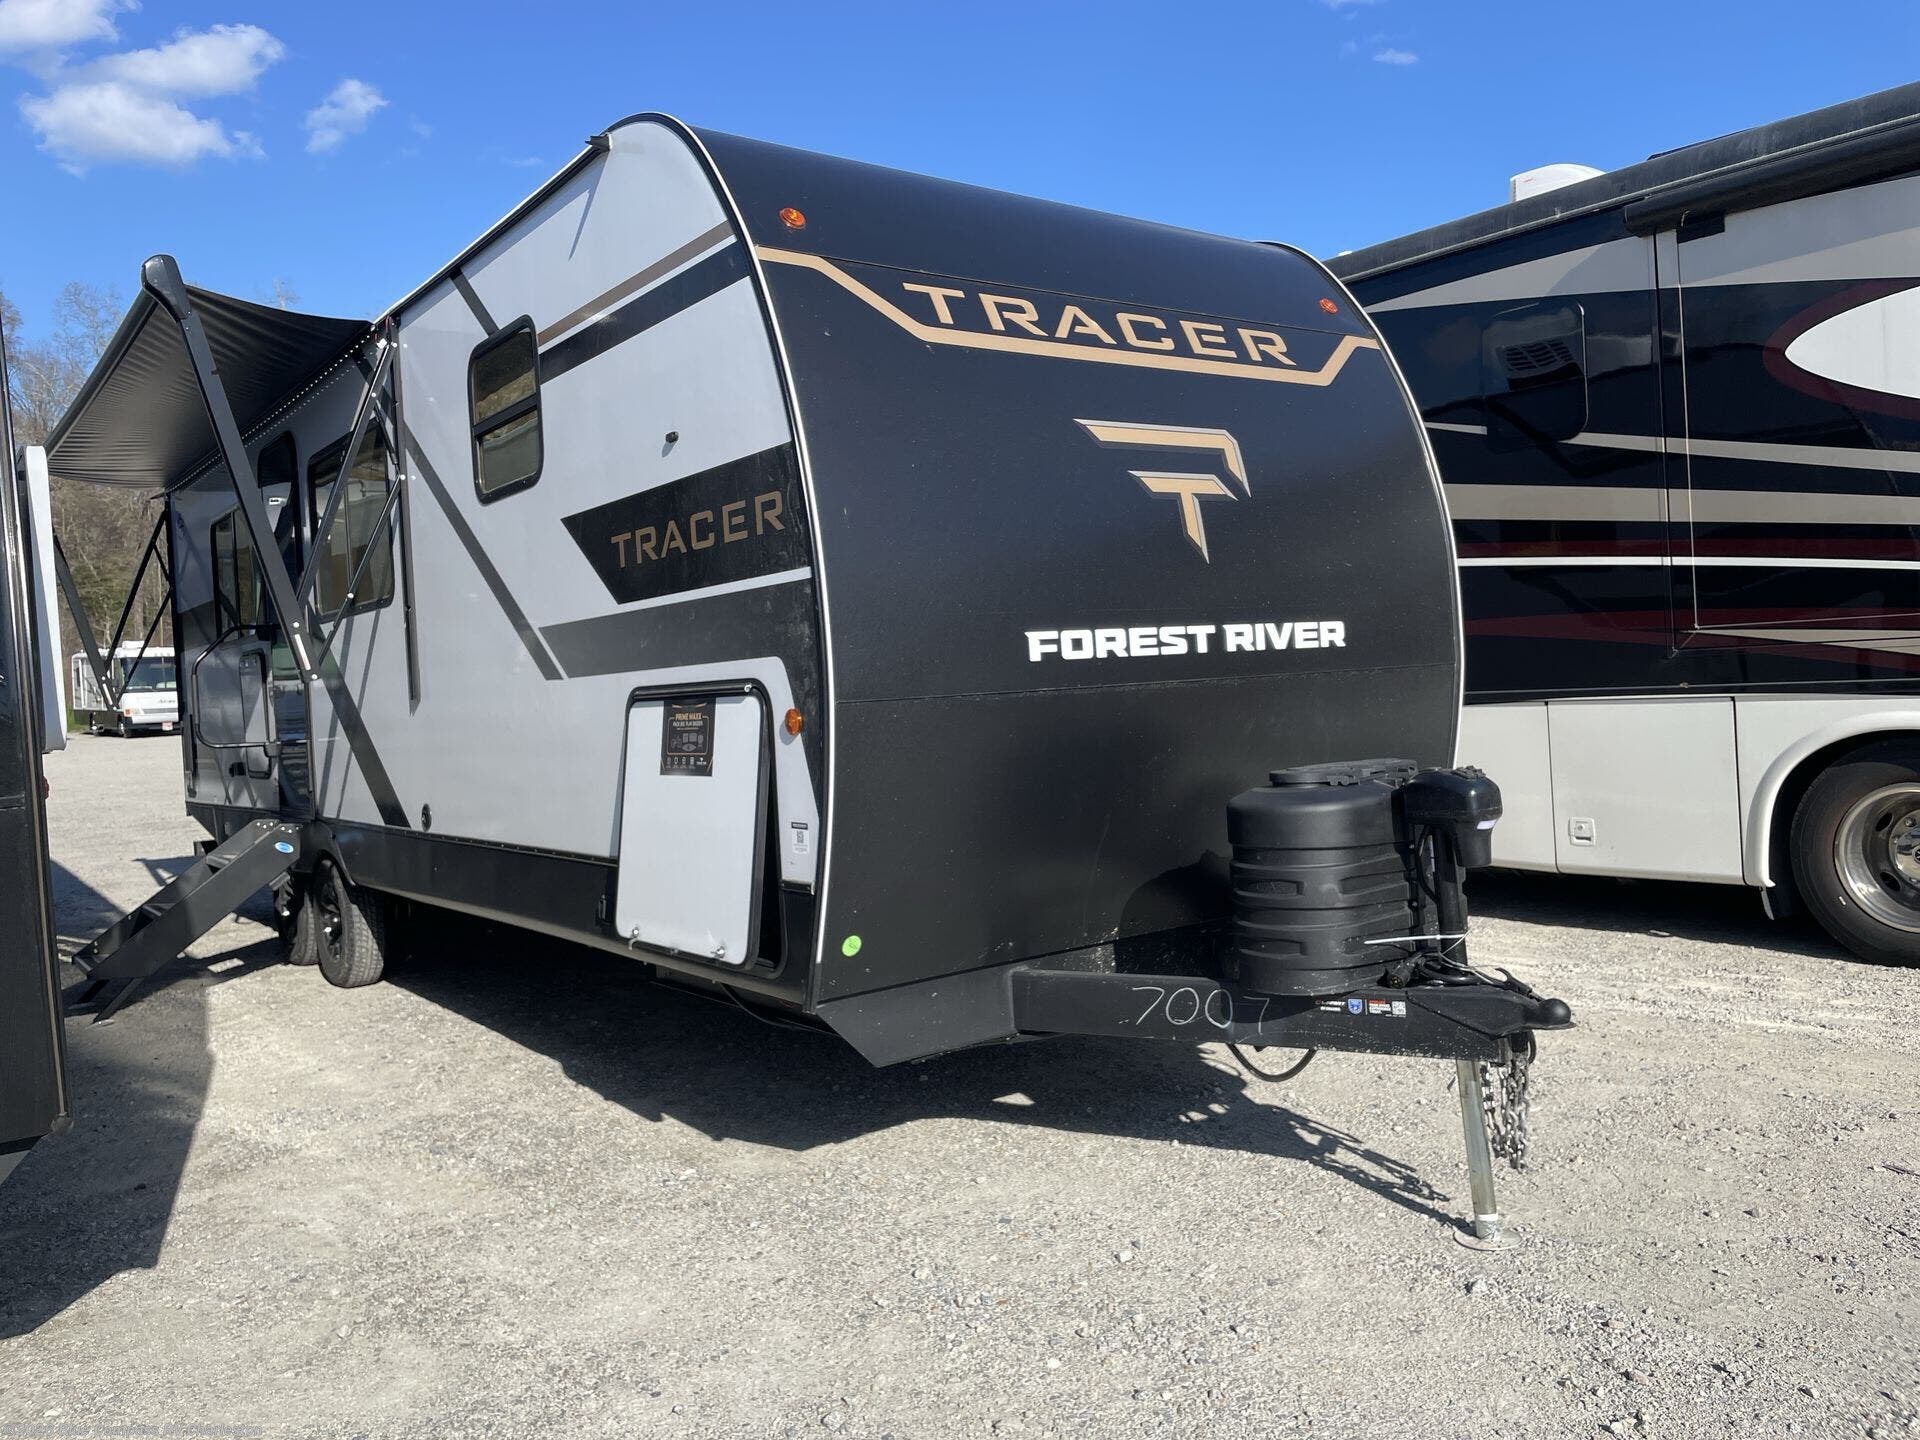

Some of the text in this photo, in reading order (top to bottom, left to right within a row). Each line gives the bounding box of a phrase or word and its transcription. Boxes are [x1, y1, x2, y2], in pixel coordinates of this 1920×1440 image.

[902, 282, 1297, 366] TRACER
[611, 490, 786, 569] TRACER
[1024, 621, 1347, 662] FOREST RIVER
[1132, 986, 1270, 1036] 7007
